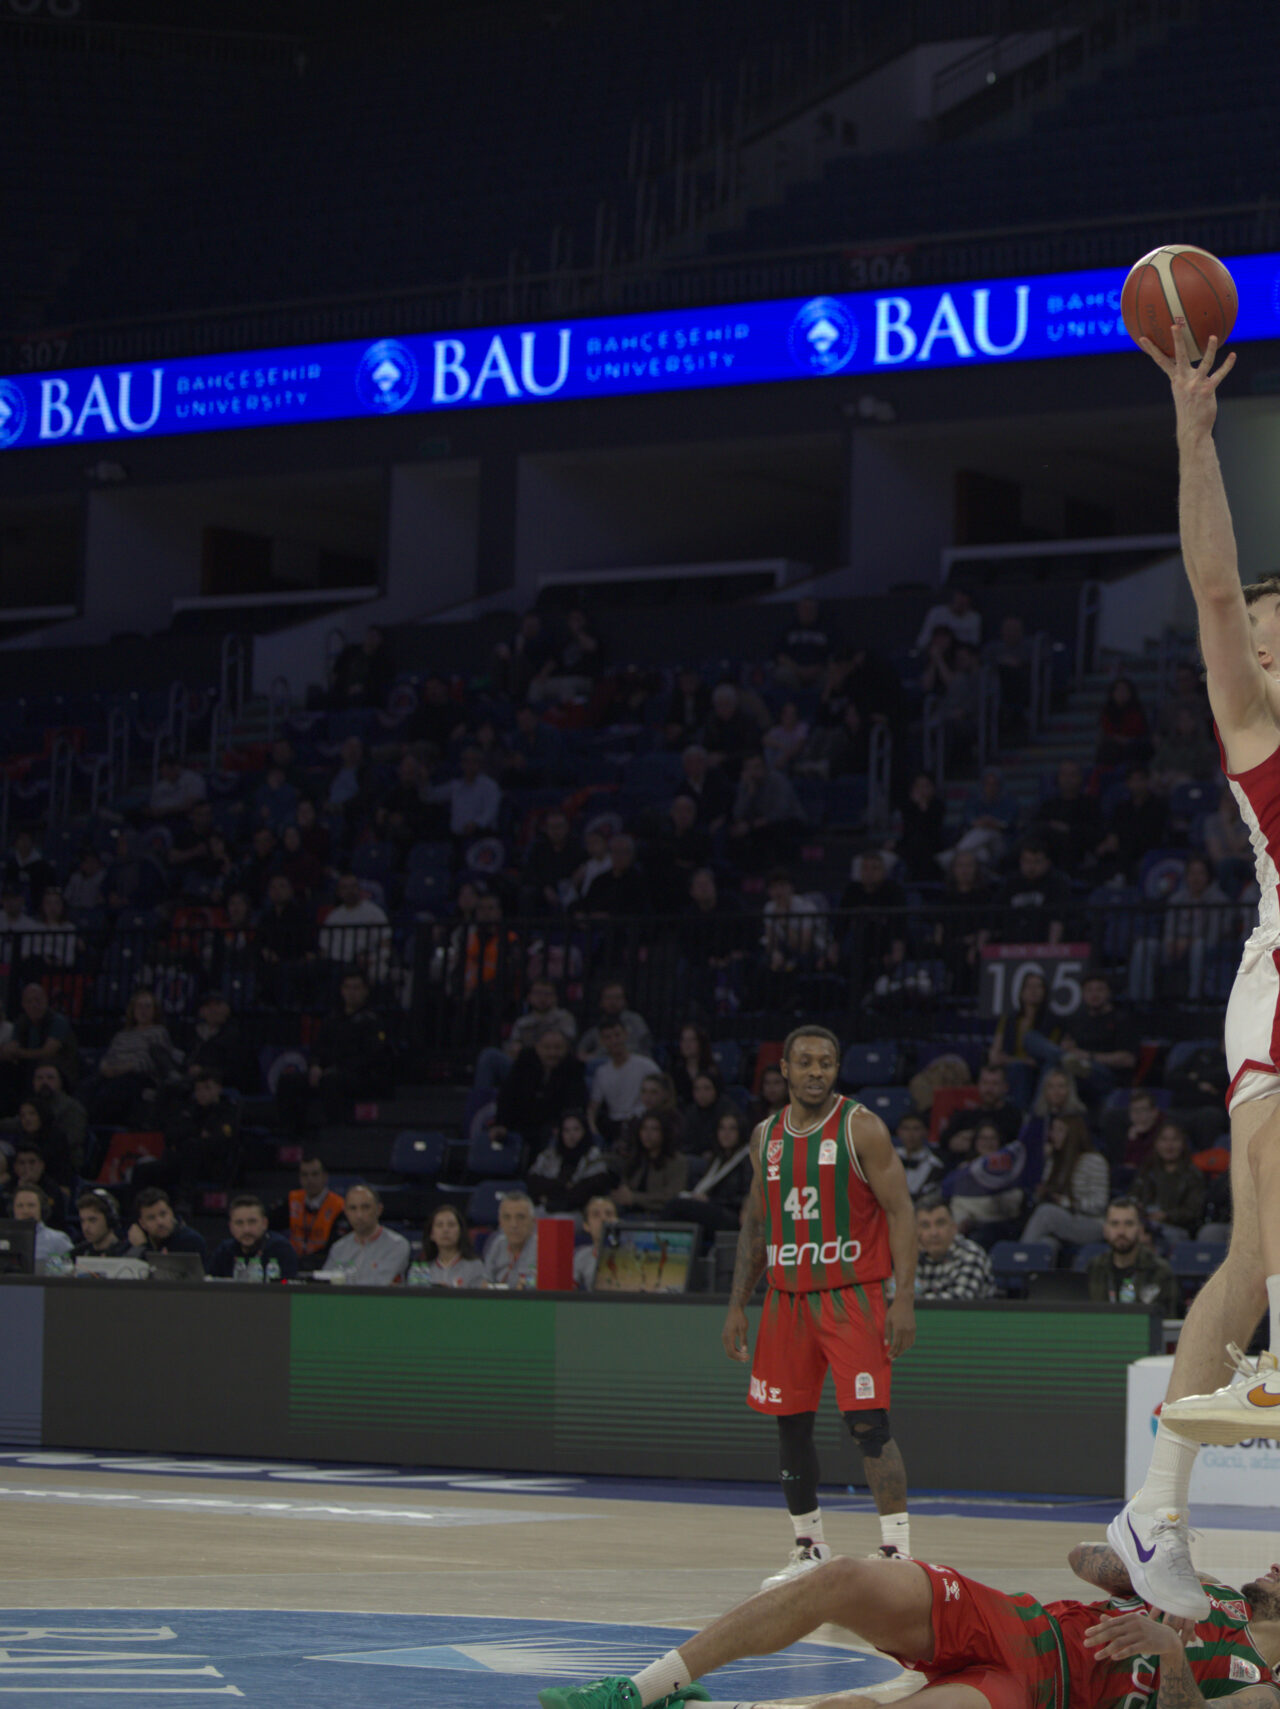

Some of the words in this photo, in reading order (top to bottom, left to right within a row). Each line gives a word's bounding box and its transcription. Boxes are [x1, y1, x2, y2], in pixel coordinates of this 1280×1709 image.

[849, 255, 912, 283] 306
[873, 285, 1030, 366] BAU
[431, 328, 572, 403] BAU
[586, 350, 735, 383] UNIVERSITY
[38, 367, 165, 439] BAU
[175, 390, 307, 418] UNIVERSITY
[987, 962, 1083, 1016] 105
[784, 1186, 819, 1220] 42
